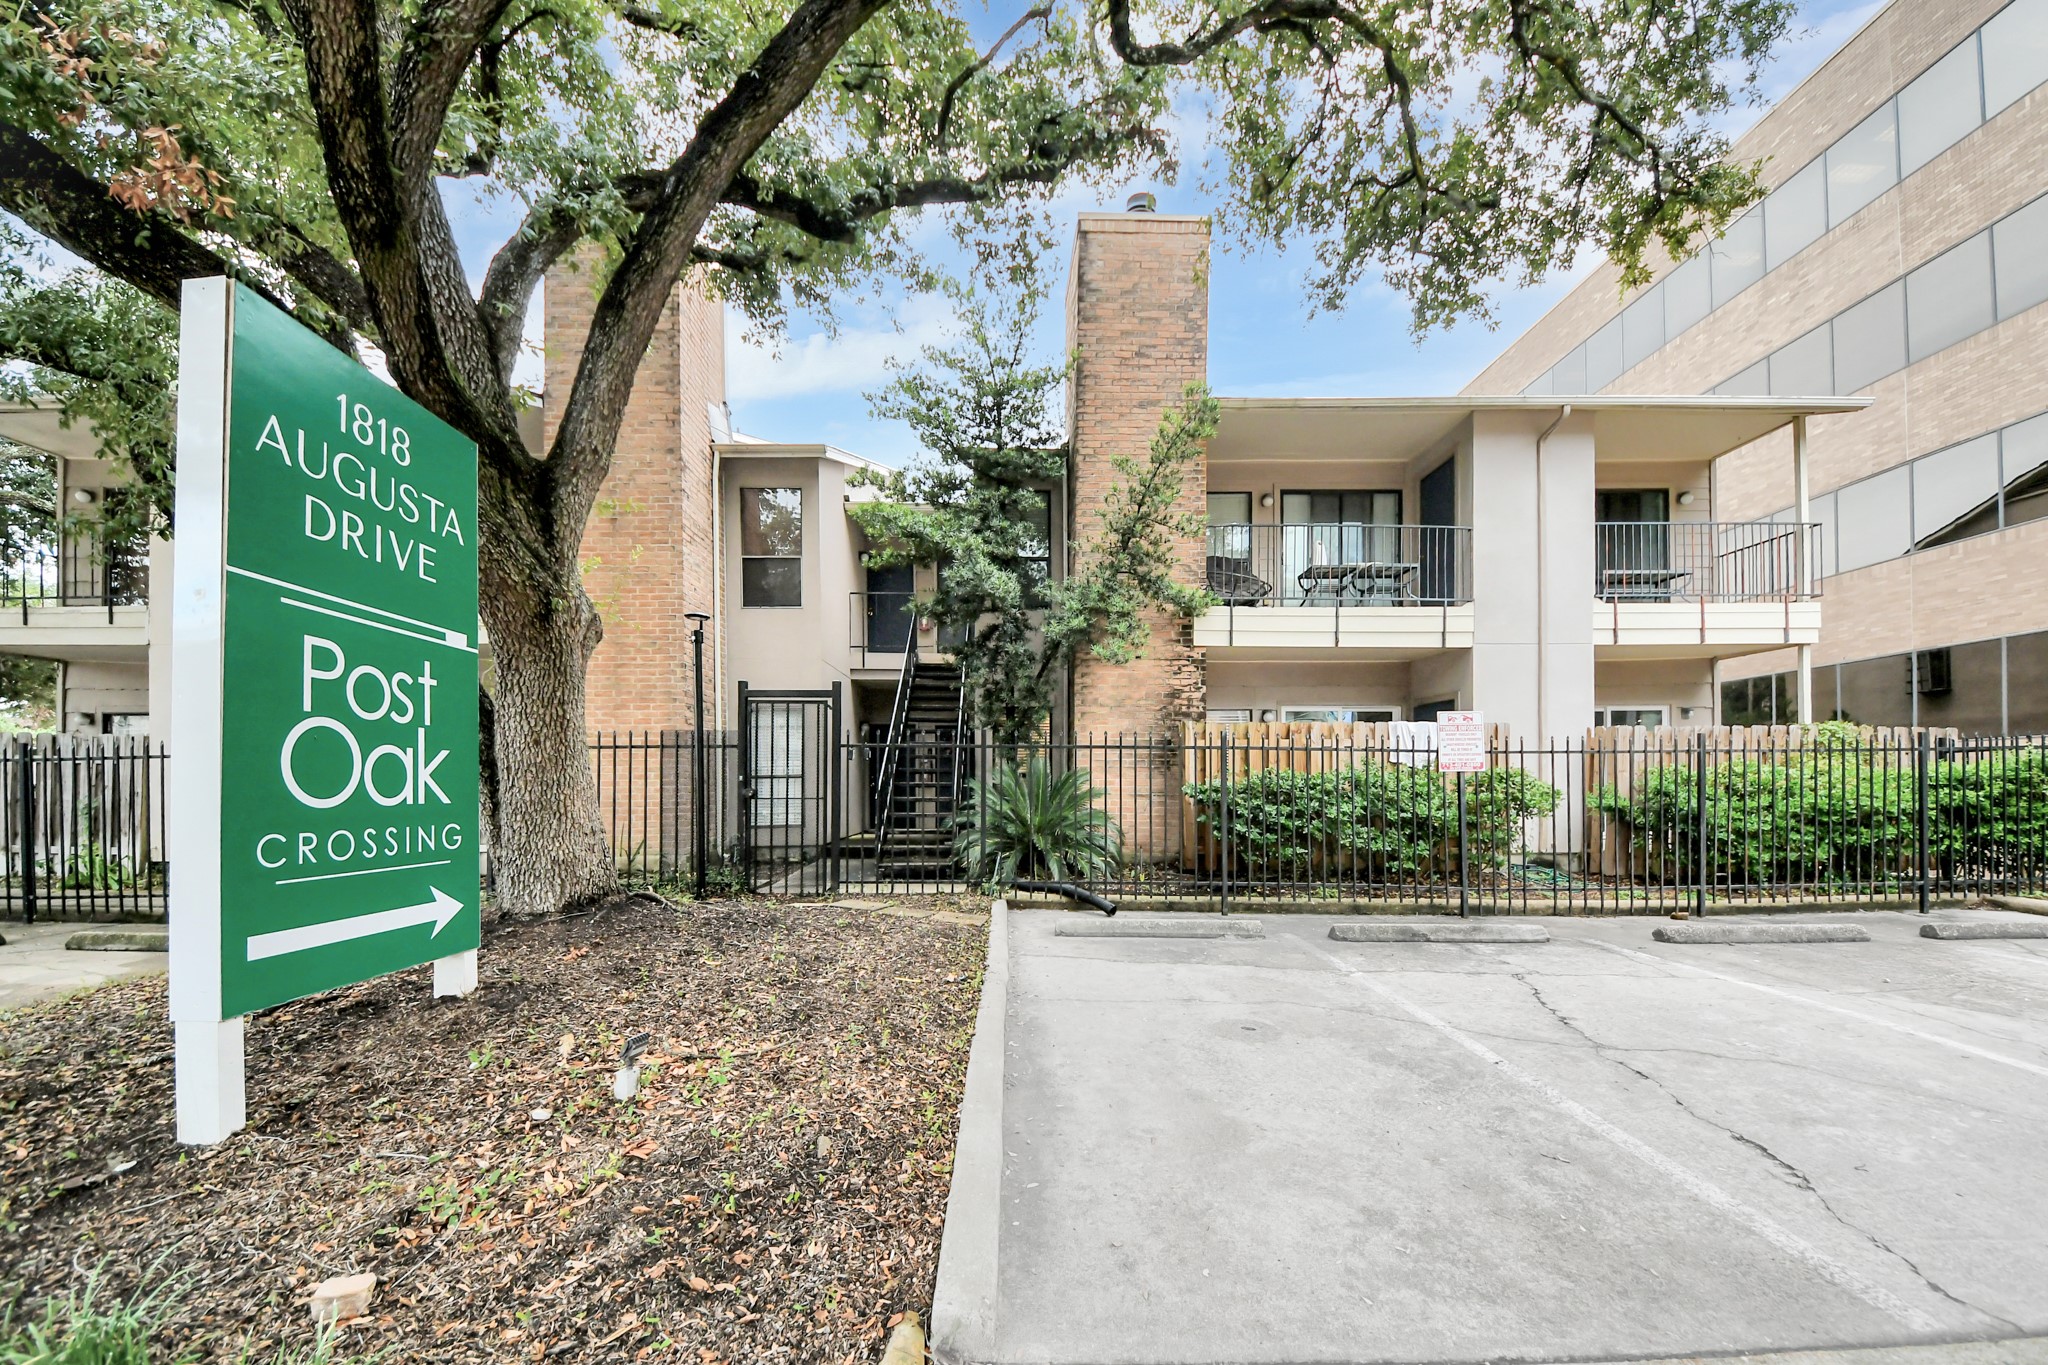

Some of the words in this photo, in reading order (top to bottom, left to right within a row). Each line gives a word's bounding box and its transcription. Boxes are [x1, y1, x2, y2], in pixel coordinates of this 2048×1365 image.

[336, 393, 411, 467] 1818
[255, 414, 465, 546] AUGUSTA
[305, 494, 437, 584] DRIVE
[303, 634, 438, 726] Post
[280, 716, 452, 809] Oak
[256, 823, 463, 868] CROSSING
